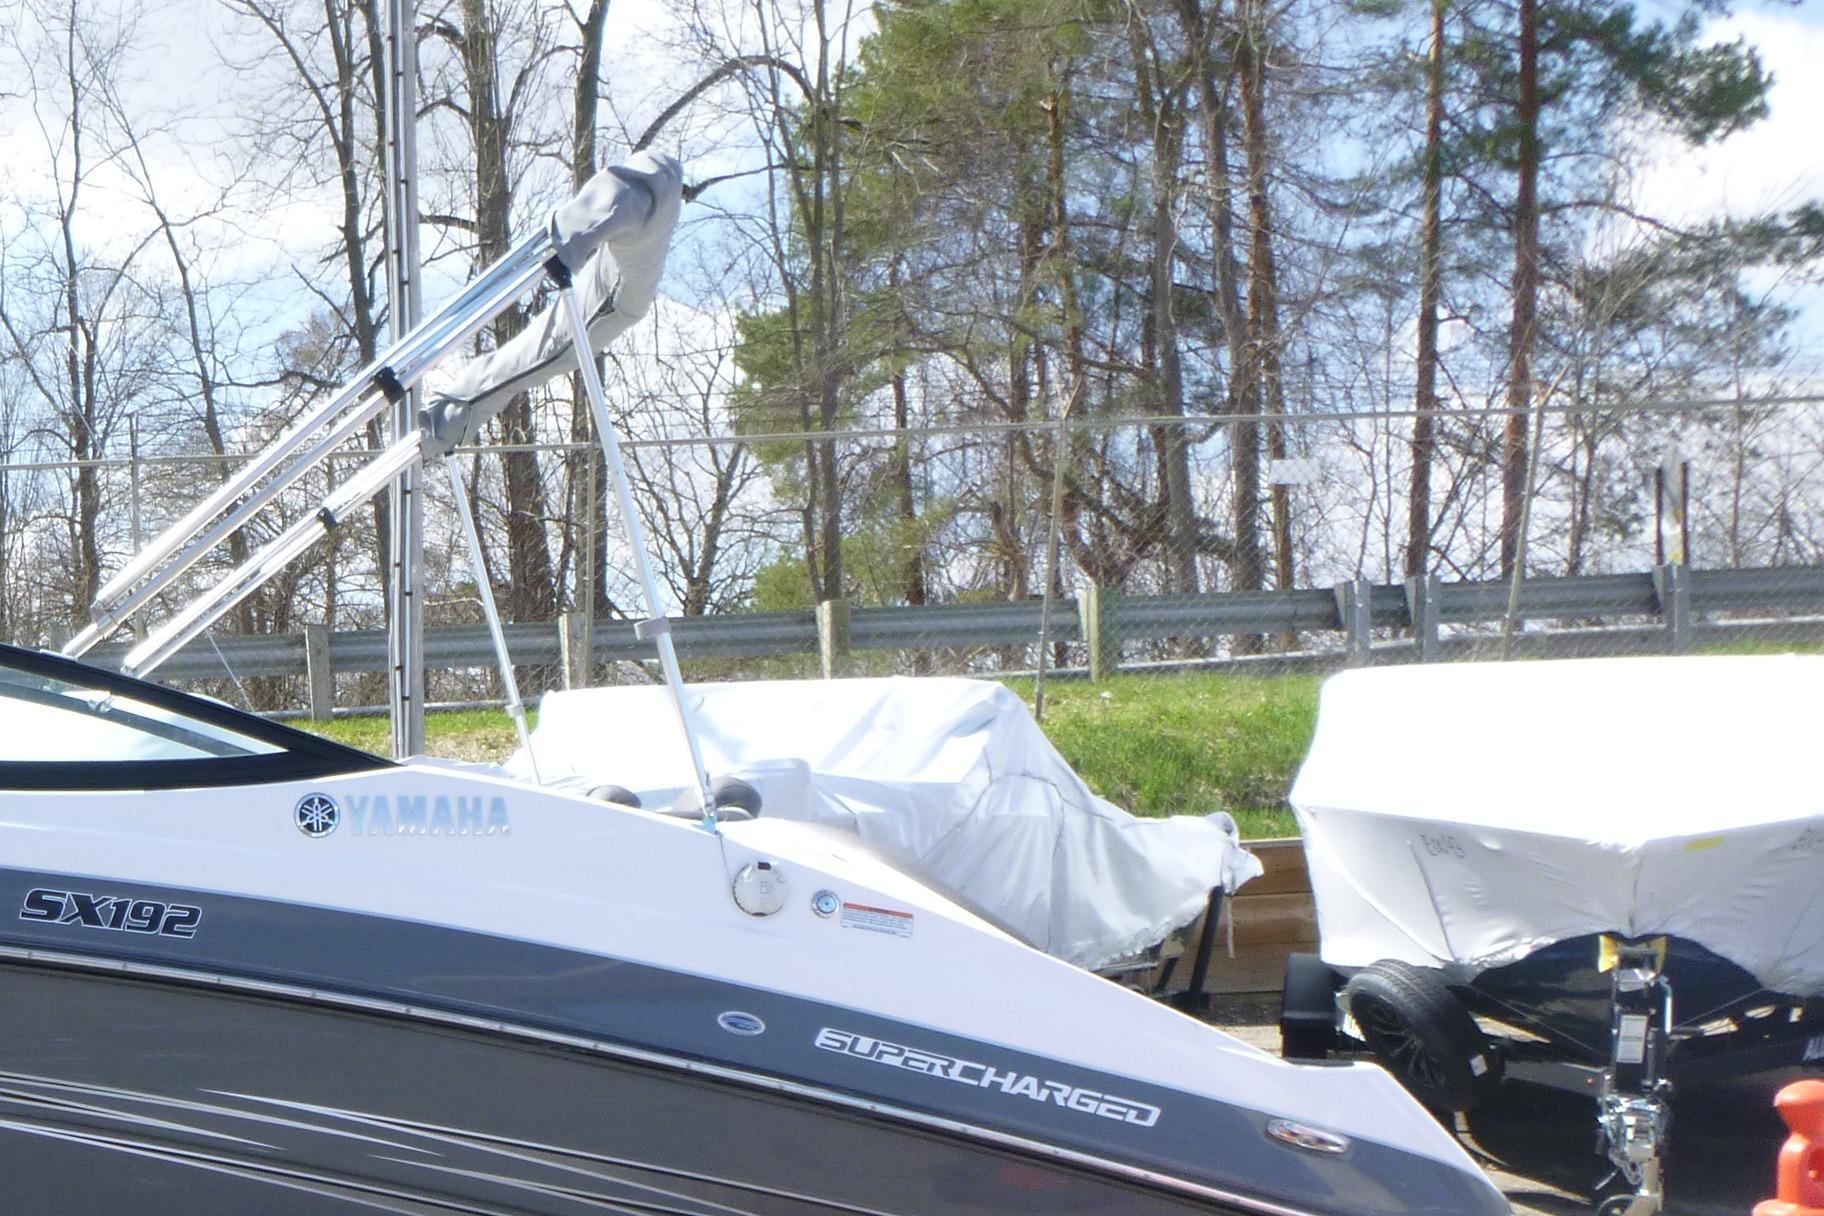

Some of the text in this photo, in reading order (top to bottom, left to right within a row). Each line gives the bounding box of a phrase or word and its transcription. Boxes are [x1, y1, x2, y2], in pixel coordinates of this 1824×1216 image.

[344, 794, 511, 837] YAMAHA
[19, 887, 203, 940] SX192
[814, 1026, 1163, 1128] SUPERCHARGED
